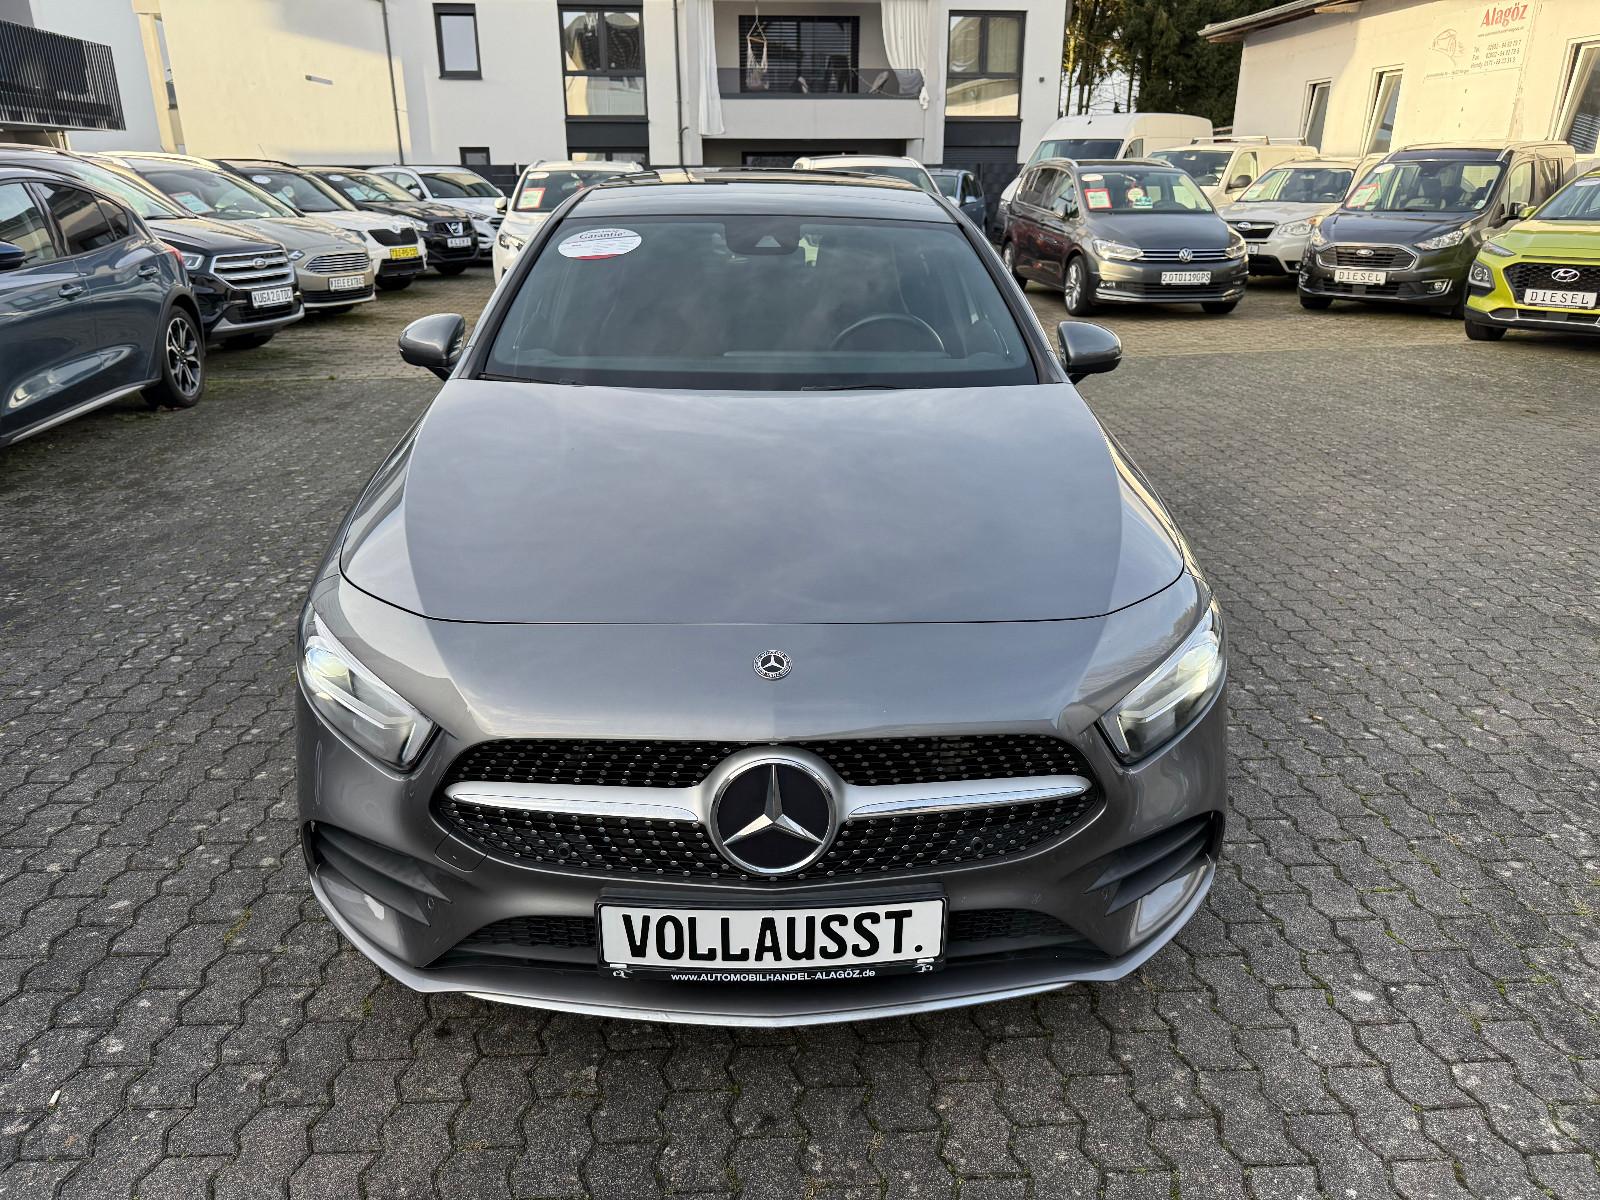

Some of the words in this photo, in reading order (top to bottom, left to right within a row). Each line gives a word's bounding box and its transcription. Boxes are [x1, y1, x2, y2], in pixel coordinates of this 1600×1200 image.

[1480, 2, 1528, 28] Alagöz
[1338, 271, 1382, 282] DIESEL
[1529, 290, 1590, 305] DIESEL
[621, 909, 924, 962] VOLLAUSST.
[670, 968, 876, 983] www.AUTOMOBILHANDEL-ALAGÖZ.de
